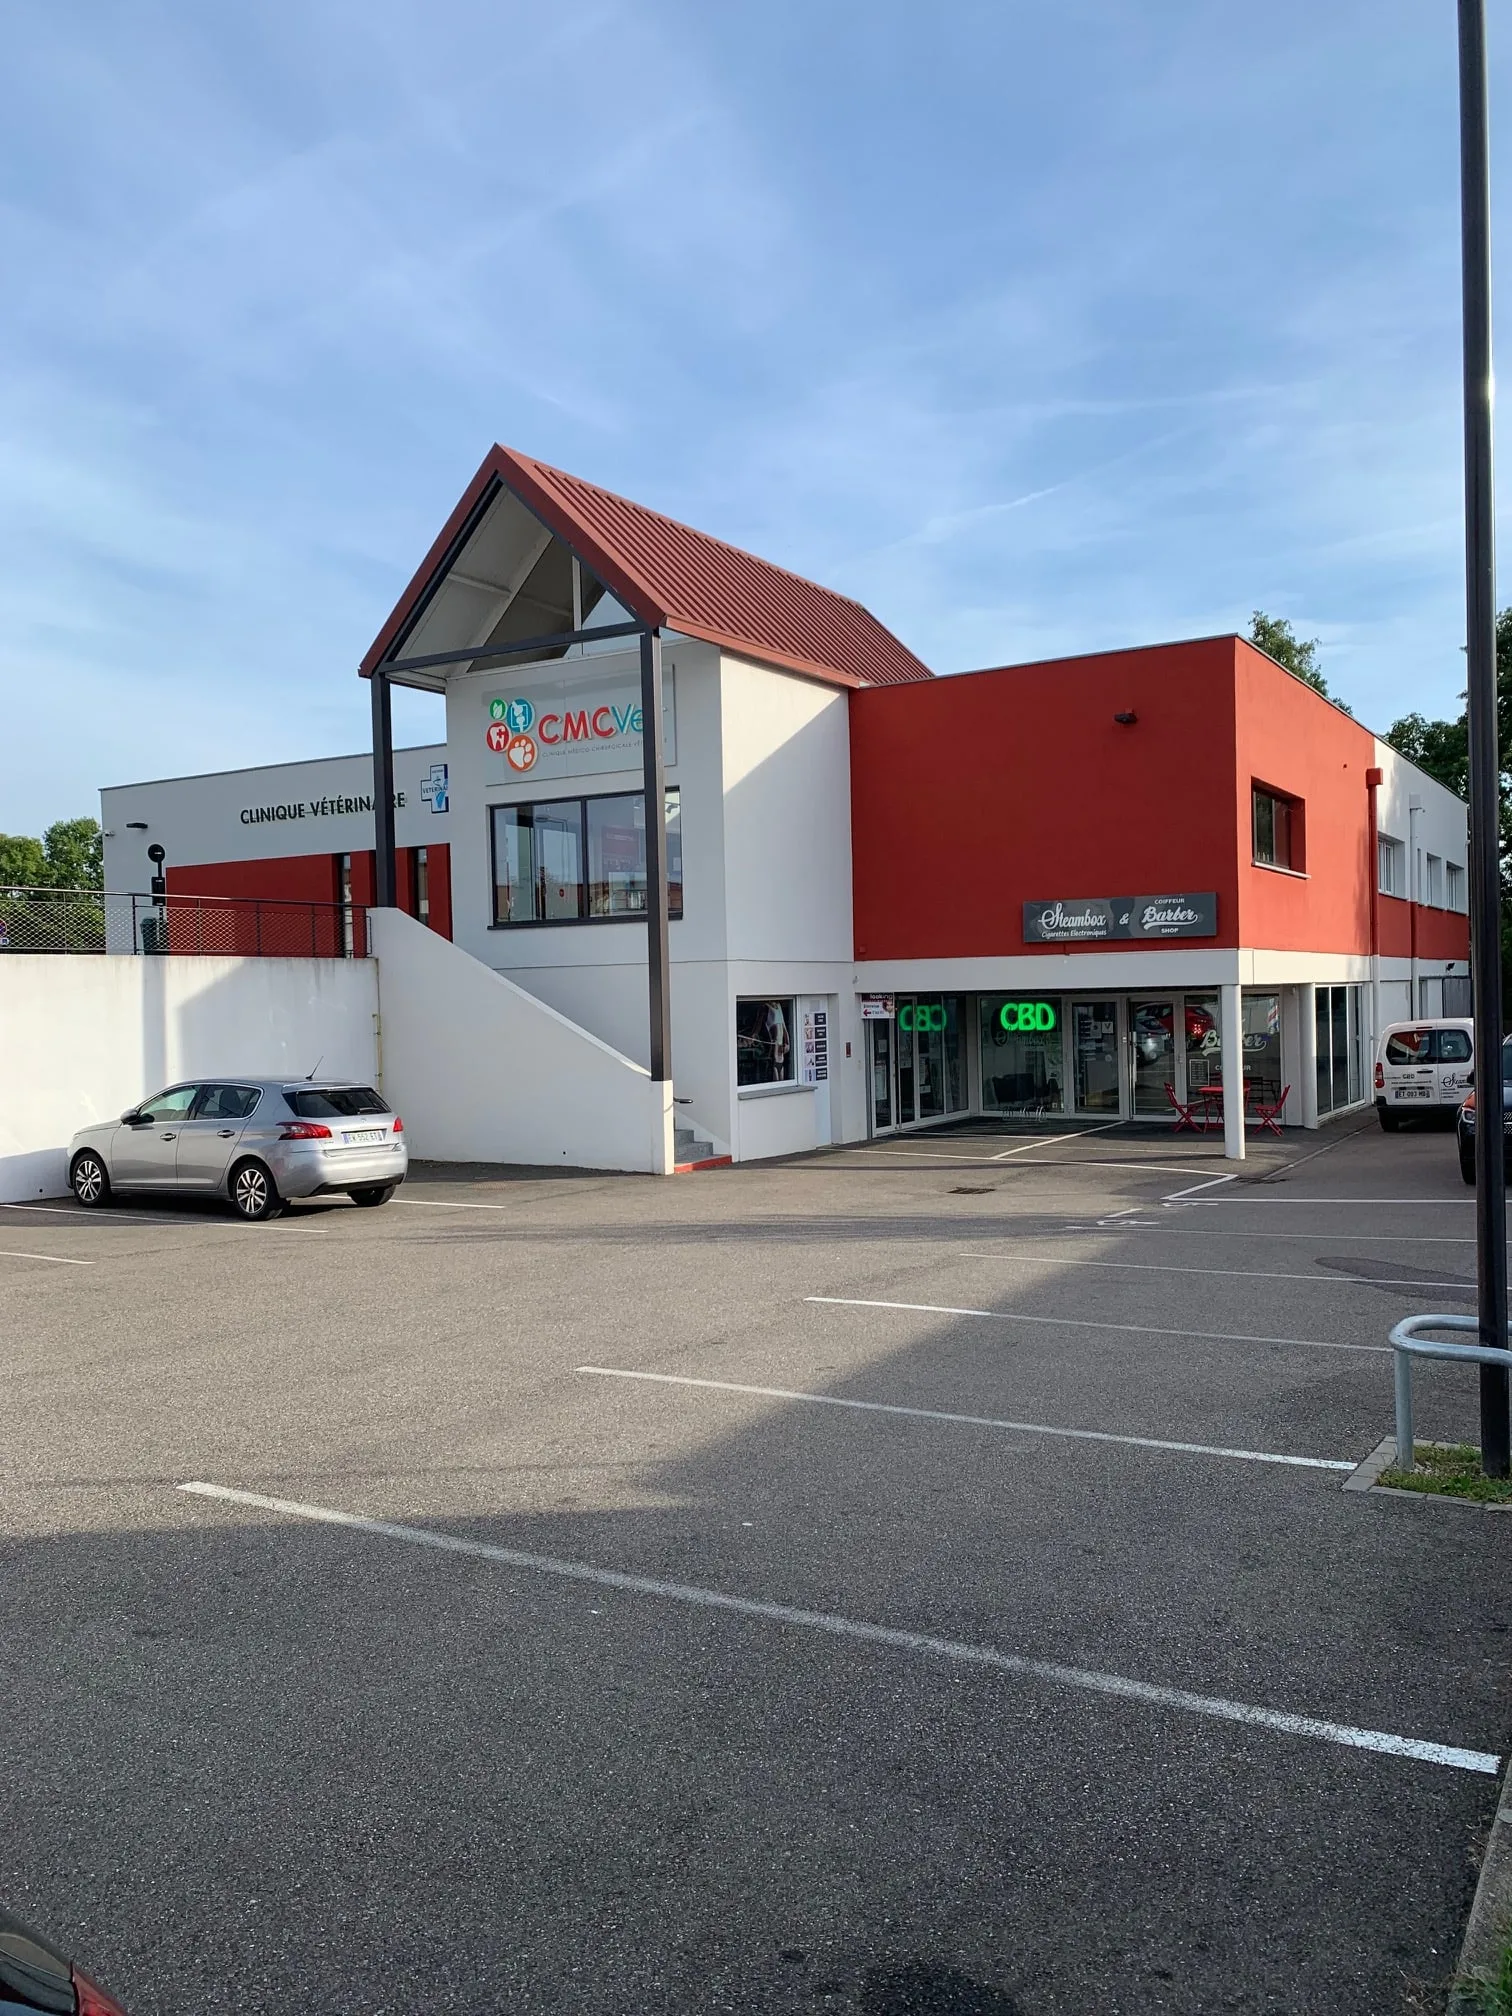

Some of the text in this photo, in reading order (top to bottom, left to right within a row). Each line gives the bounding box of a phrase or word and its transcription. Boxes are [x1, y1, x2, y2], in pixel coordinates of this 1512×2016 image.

[538, 704, 643, 745] CMCVe
[241, 792, 406, 824] CLINIQUE VÉTÉRINE
[1038, 902, 1198, 930] Steambox & Barber
[1042, 931, 1070, 940] Cigarettes
[1001, 1002, 1055, 1031] CBD
